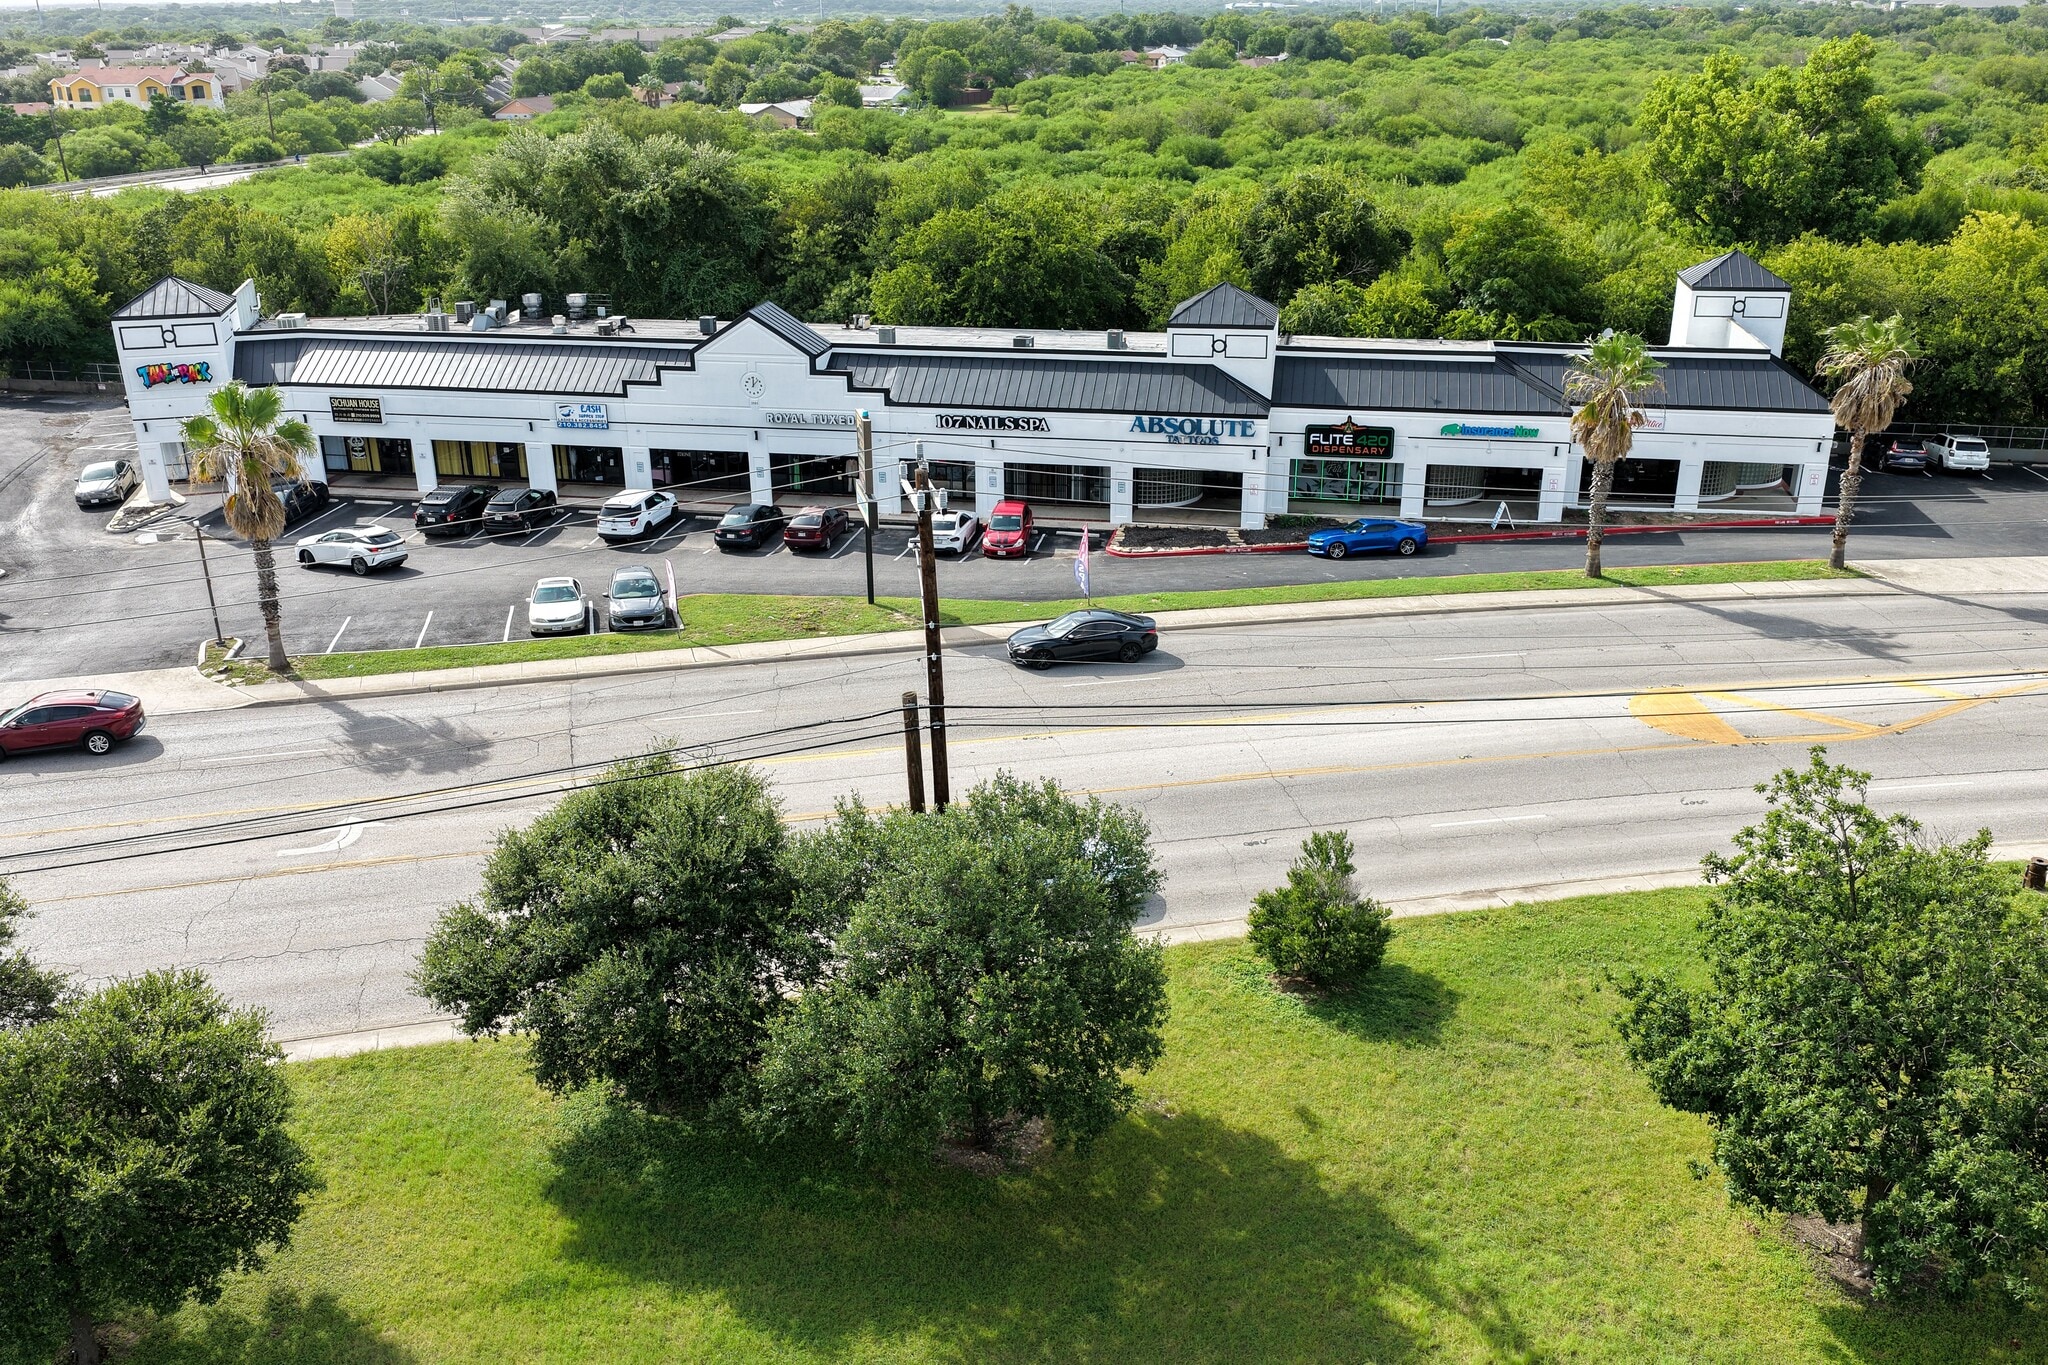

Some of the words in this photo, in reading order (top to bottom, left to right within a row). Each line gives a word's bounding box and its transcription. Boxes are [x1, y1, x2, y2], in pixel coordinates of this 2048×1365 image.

[173, 361, 213, 384] BACK
[331, 398, 358, 408] SICHUAN
[358, 400, 380, 409] HOUSE
[581, 404, 602, 413] LASH
[766, 413, 807, 424] ROYAL
[811, 414, 855, 426] TUXED
[936, 414, 963, 428] 107
[965, 416, 1015, 430] NAILS
[1018, 417, 1050, 432] SPA
[1129, 416, 1256, 438] ABSOLUTE
[1309, 433, 1354, 445] FLITE
[1356, 435, 1389, 447] 420
[1312, 445, 1385, 455] DISPENSARY
